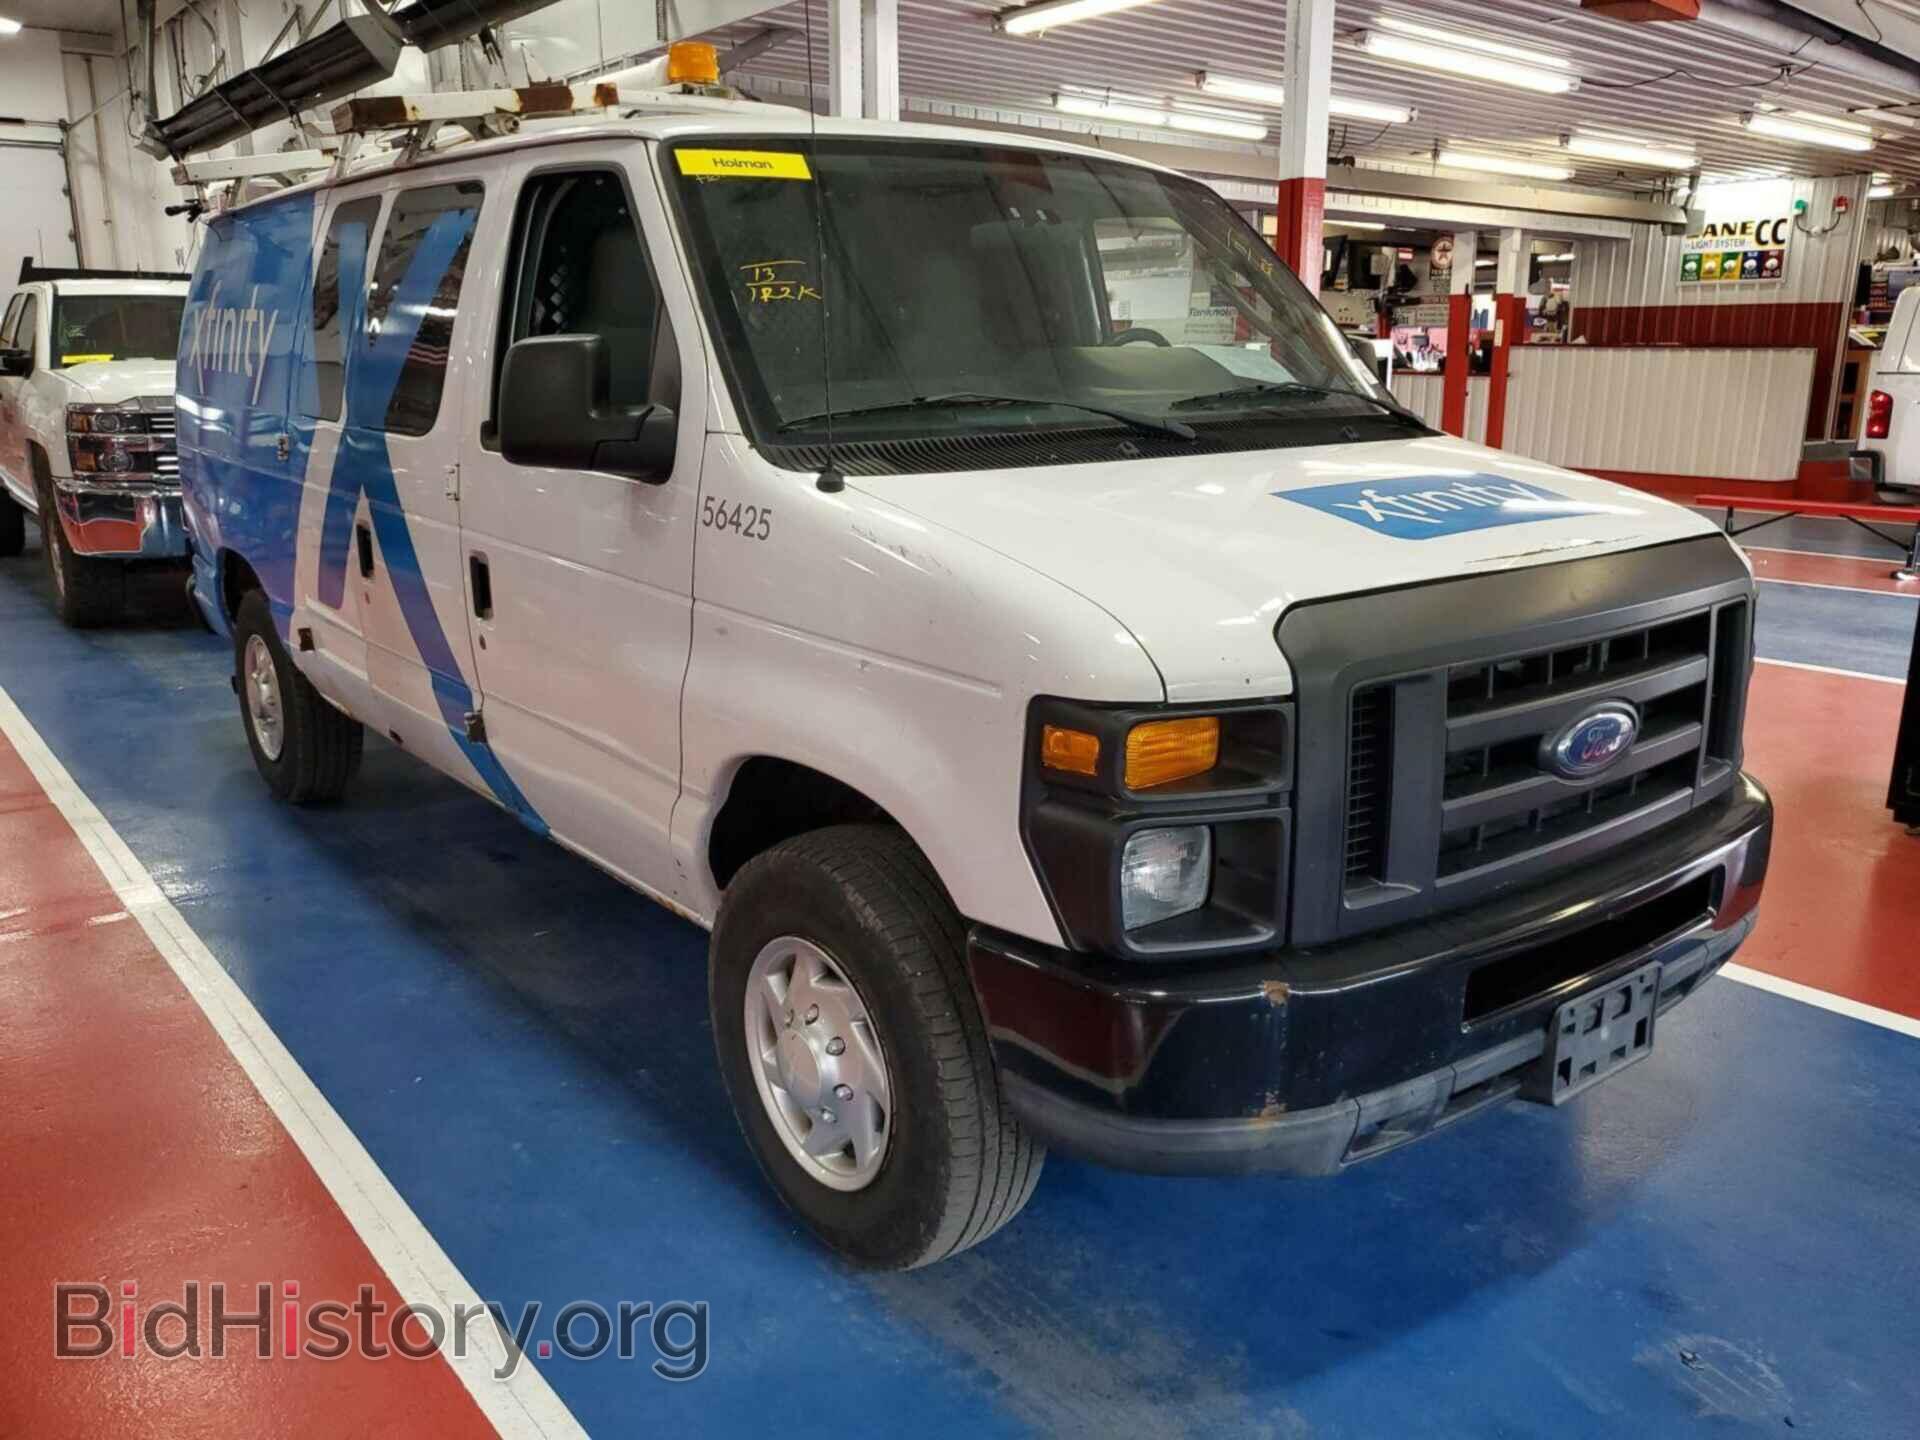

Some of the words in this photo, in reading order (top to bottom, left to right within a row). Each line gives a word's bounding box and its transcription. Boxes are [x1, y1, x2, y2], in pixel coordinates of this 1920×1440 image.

[712, 157, 774, 169] Holman
[1755, 218, 1788, 246] CC
[187, 279, 279, 406] xfinity
[702, 495, 772, 541] 56425
[1331, 482, 1541, 524] xfinity
